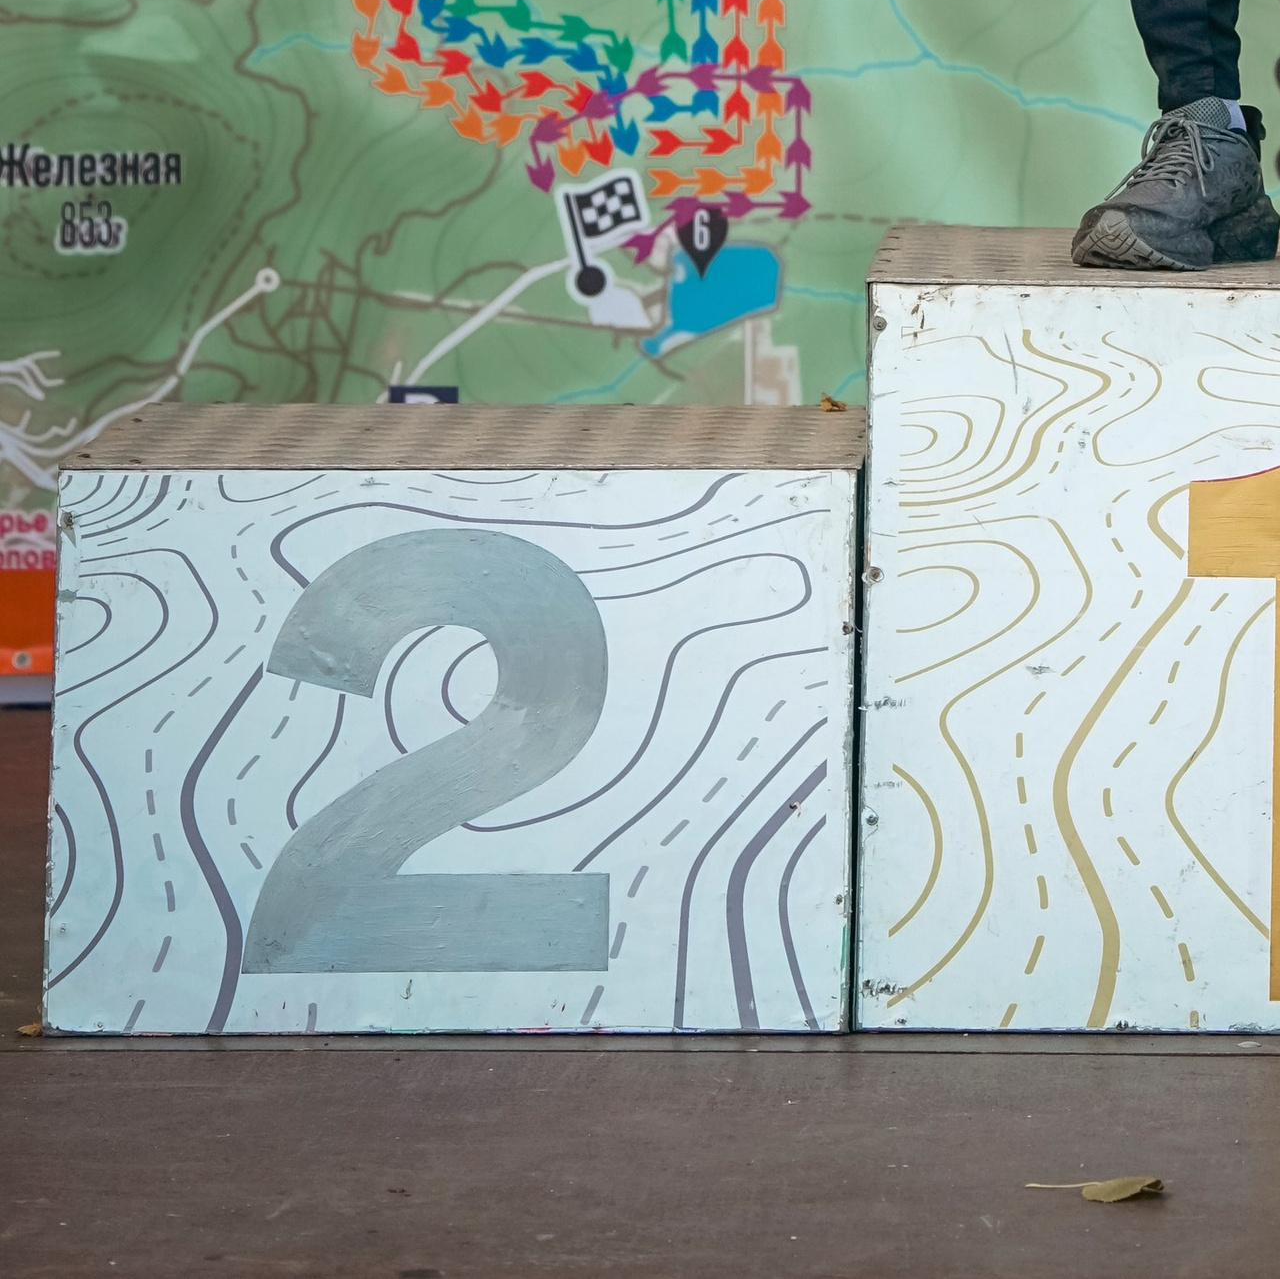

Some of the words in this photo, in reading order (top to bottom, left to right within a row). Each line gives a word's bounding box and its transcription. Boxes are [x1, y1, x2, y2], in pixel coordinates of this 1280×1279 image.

[0, 143, 182, 188] Железная
[693, 212, 709, 249] 6
[242, 528, 609, 973] 2
